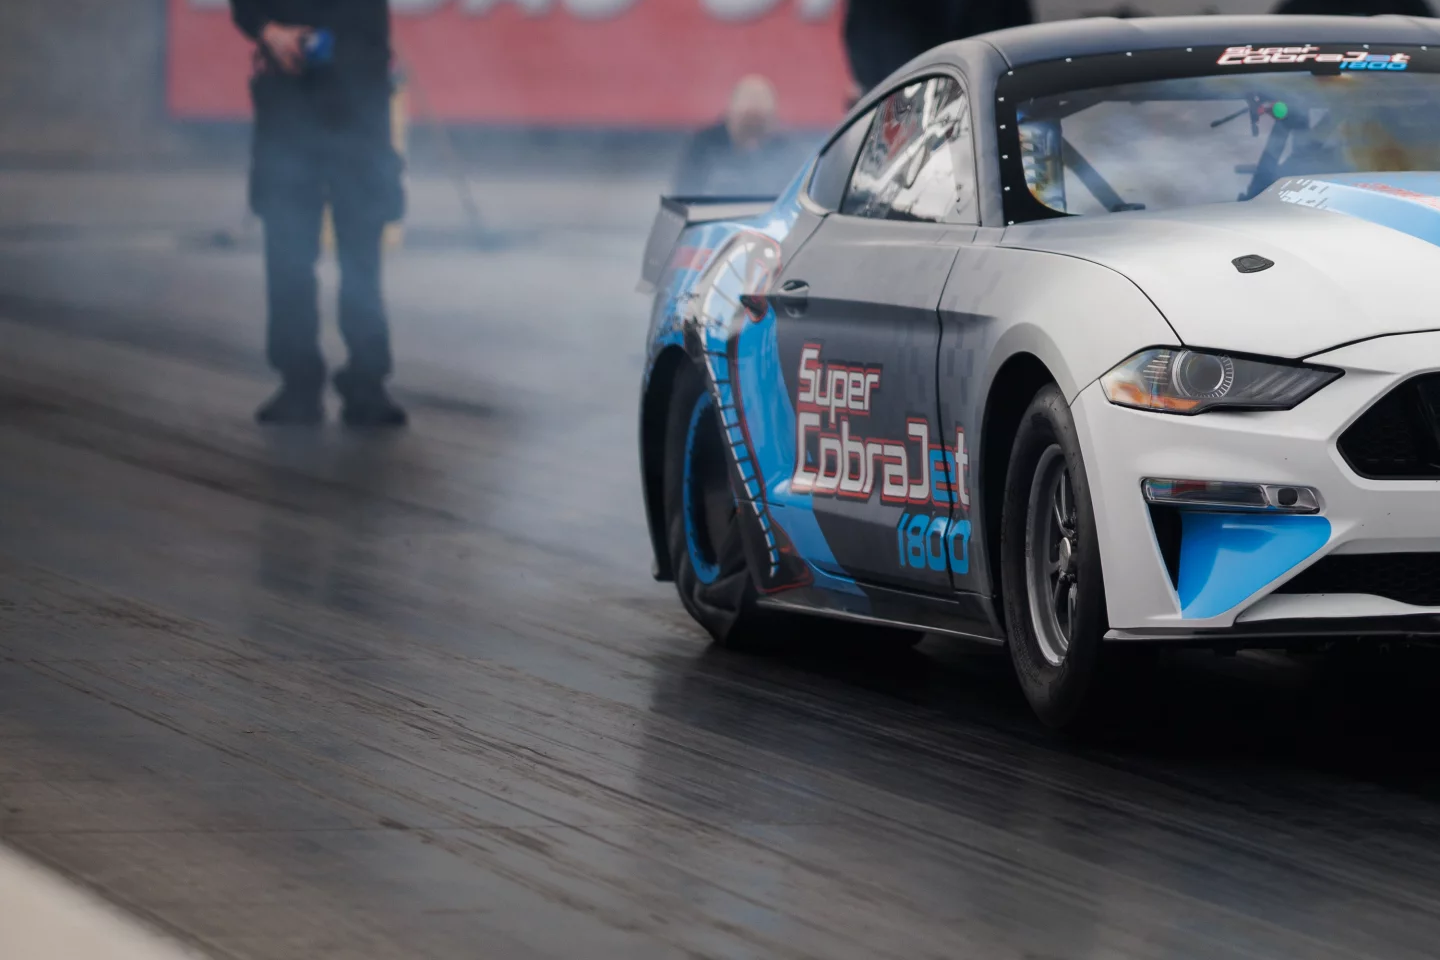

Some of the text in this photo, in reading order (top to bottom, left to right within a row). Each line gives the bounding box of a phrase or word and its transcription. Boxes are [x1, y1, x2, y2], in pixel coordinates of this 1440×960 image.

[1224, 44, 1320, 55] Super
[1338, 61, 1408, 70] 1800
[797, 343, 881, 428] Super
[897, 512, 972, 574] 1800
